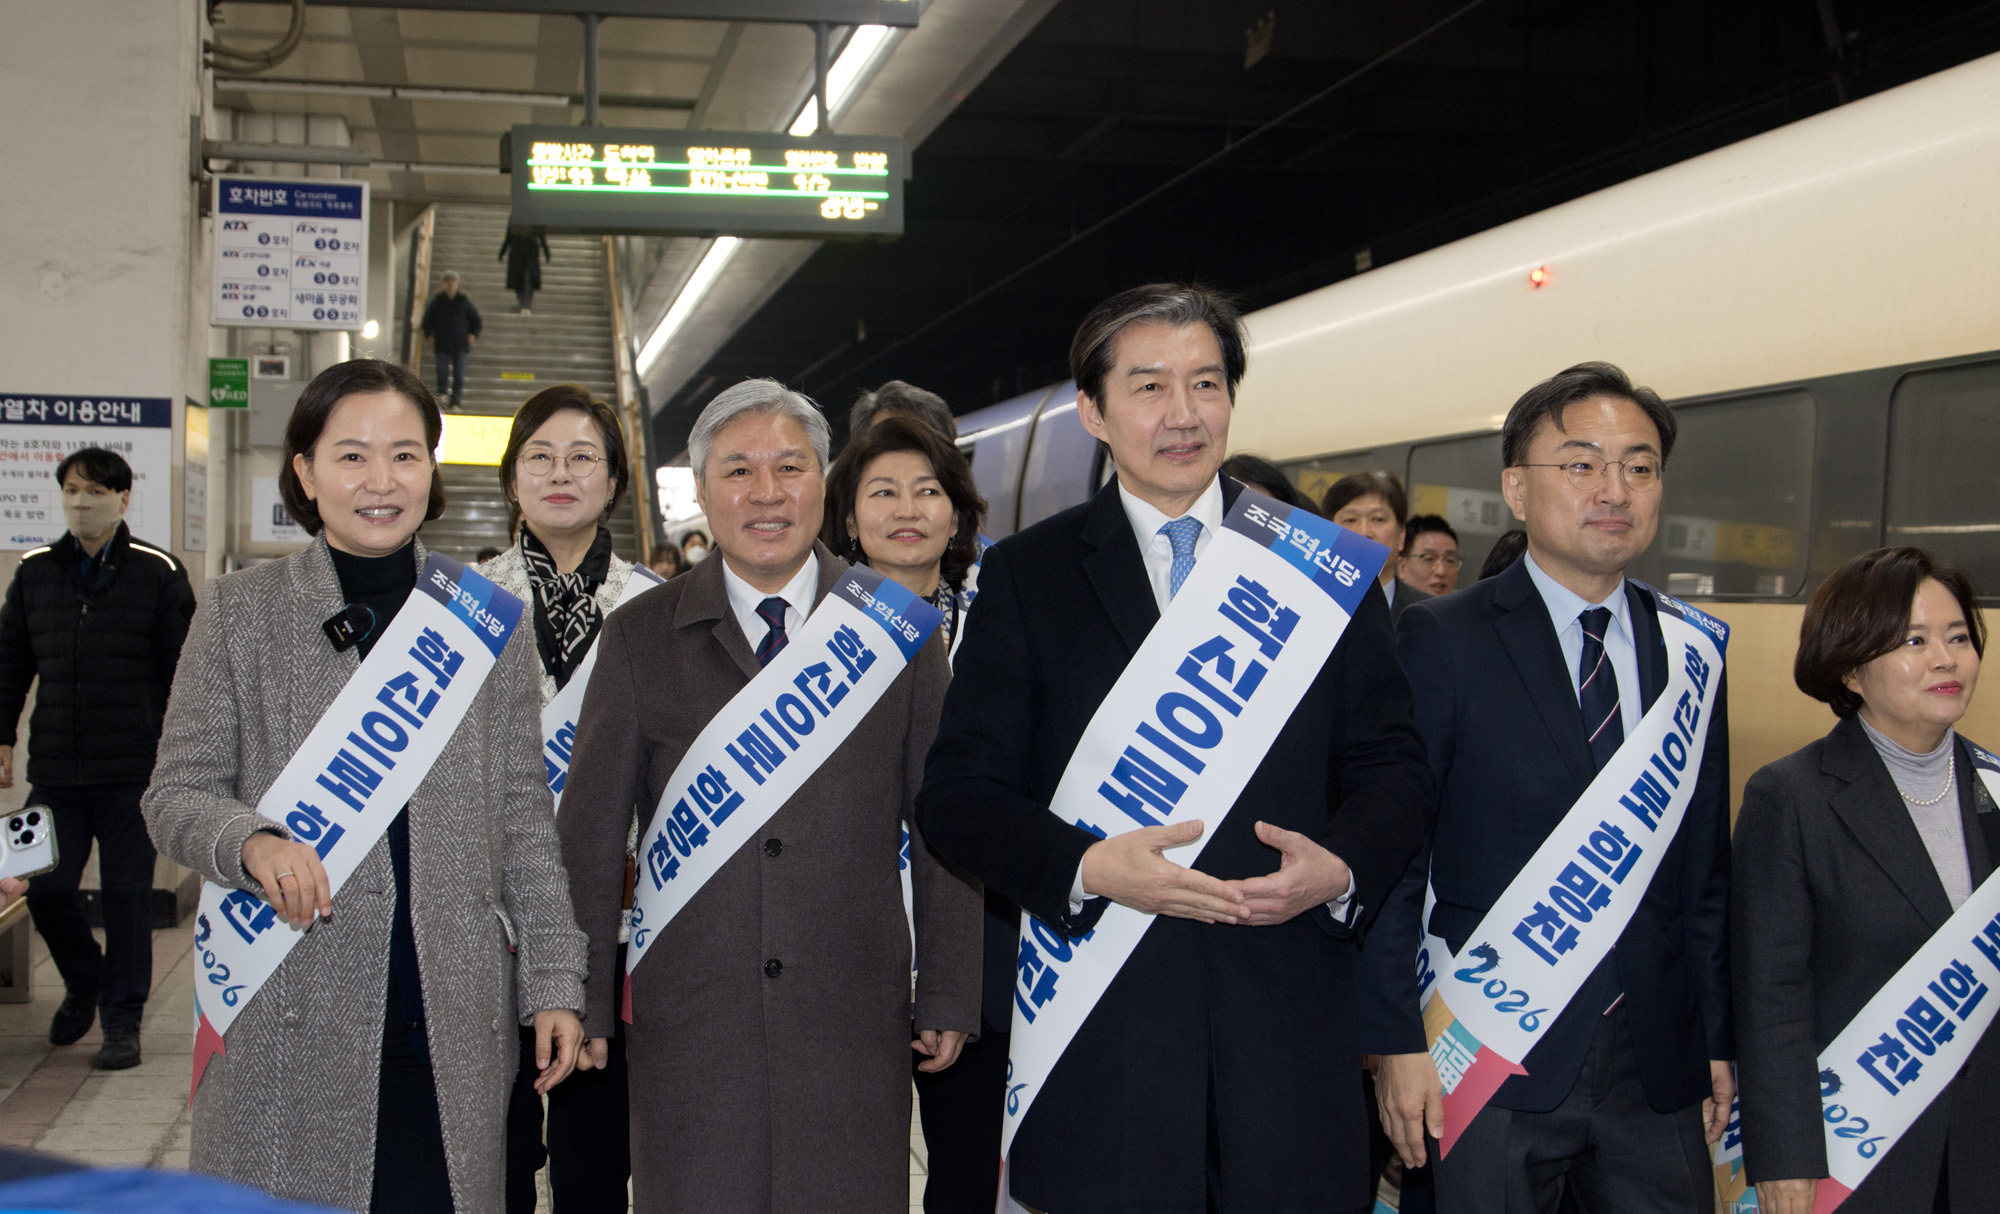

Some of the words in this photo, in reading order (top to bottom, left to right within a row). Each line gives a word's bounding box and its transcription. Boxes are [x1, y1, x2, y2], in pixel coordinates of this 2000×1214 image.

[223, 220, 250, 231] KTX
[229, 187, 288, 207] 호차번호
[295, 292, 324, 305] 새마을
[328, 293, 358, 306] 무궁화
[0, 398, 49, 421] 열차
[54, 400, 141, 424] 이용안내
[228, 390, 247, 400] AED
[0, 494, 17, 502] PO
[10, 534, 45, 543] KORAIL
[1243, 503, 1361, 587] 조국혁신당
[430, 568, 506, 639] 조국혁신당
[845, 579, 920, 643] 조국혁신당
[1657, 591, 1726, 642] 조국혁신당
[315, 625, 465, 813] 혁신으로
[724, 623, 878, 787] 혁신으로
[1097, 574, 1302, 827] 혁신으로
[1618, 641, 1710, 834] 혁신으로
[647, 763, 746, 892] 희망찬
[218, 799, 347, 945] 희찬
[1511, 819, 1644, 968] 희망찬
[194, 911, 249, 1008] 2026
[1453, 941, 1551, 1033] 2026
[1856, 957, 1989, 1097] 희망찬
